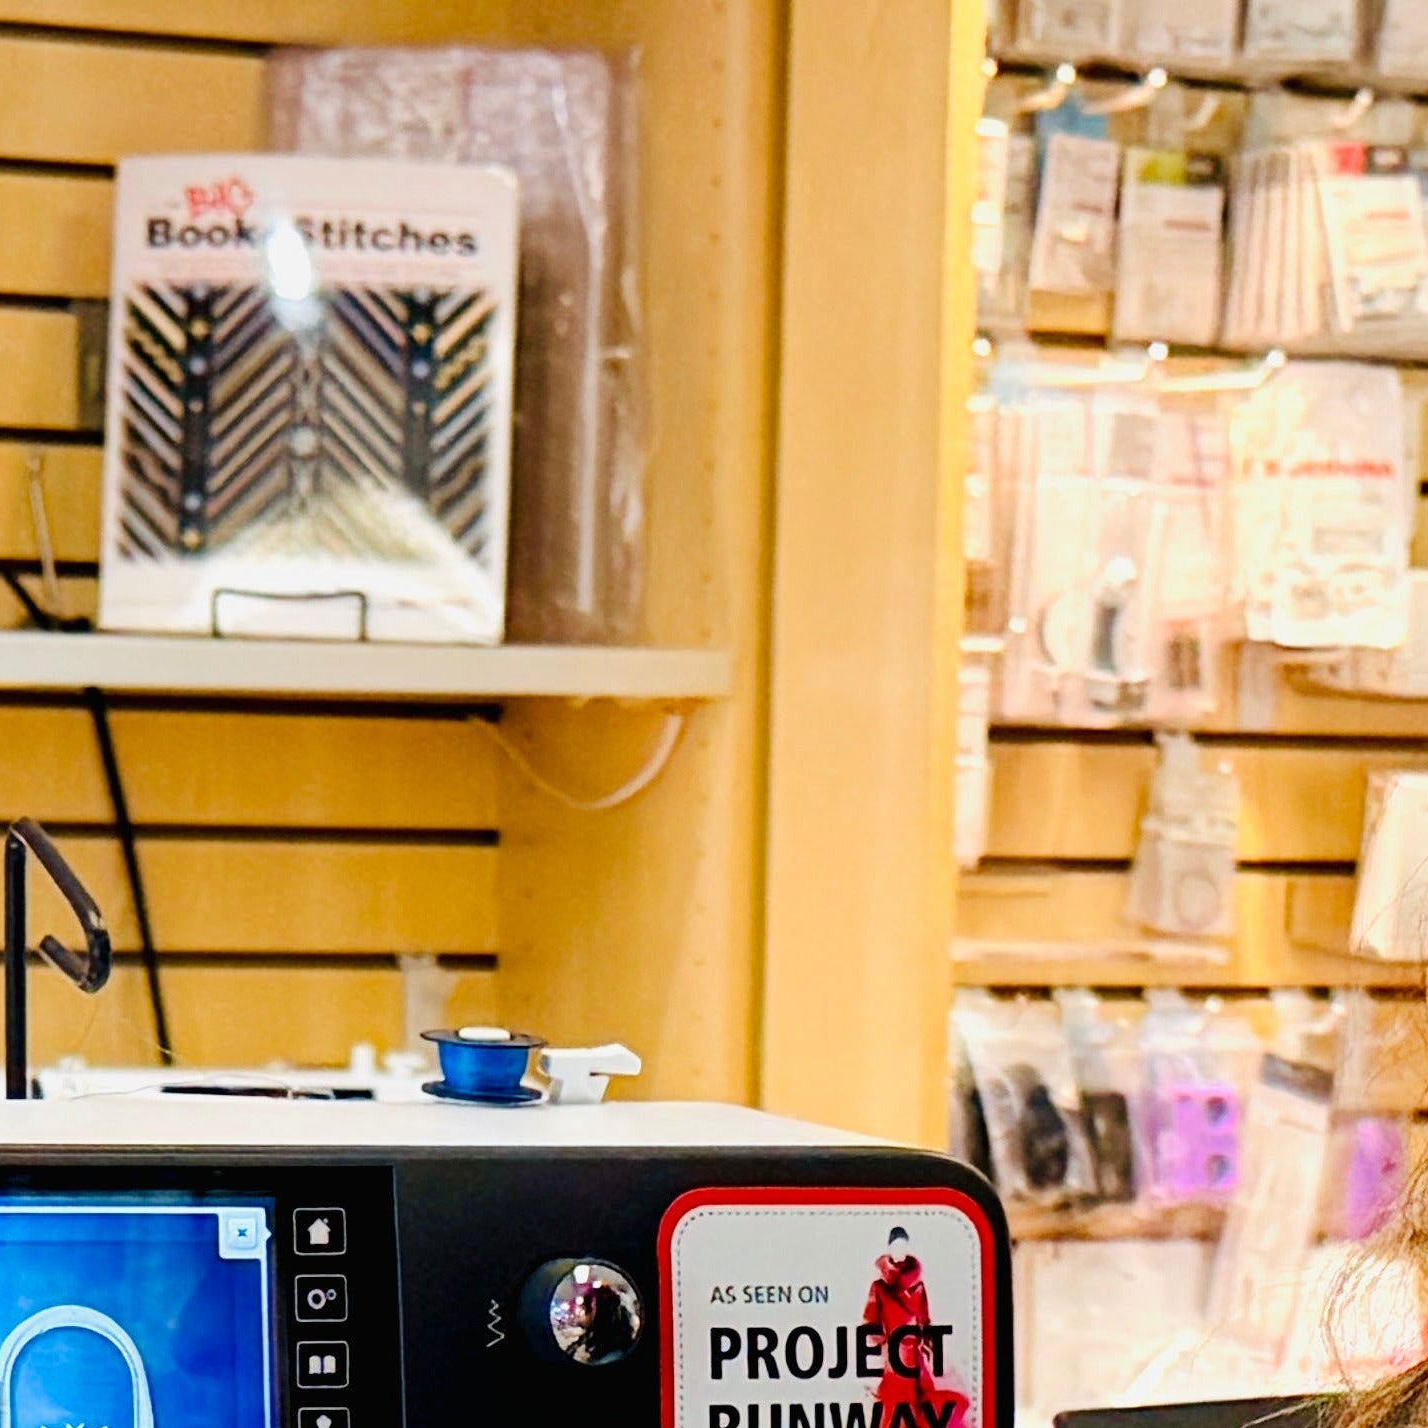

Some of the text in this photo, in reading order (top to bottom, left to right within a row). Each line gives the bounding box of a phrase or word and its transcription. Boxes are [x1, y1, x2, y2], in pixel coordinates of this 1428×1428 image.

[146, 217, 256, 249] Book
[710, 1285, 829, 1304] AS SEEN ON
[710, 1325, 953, 1380] PROJECT
